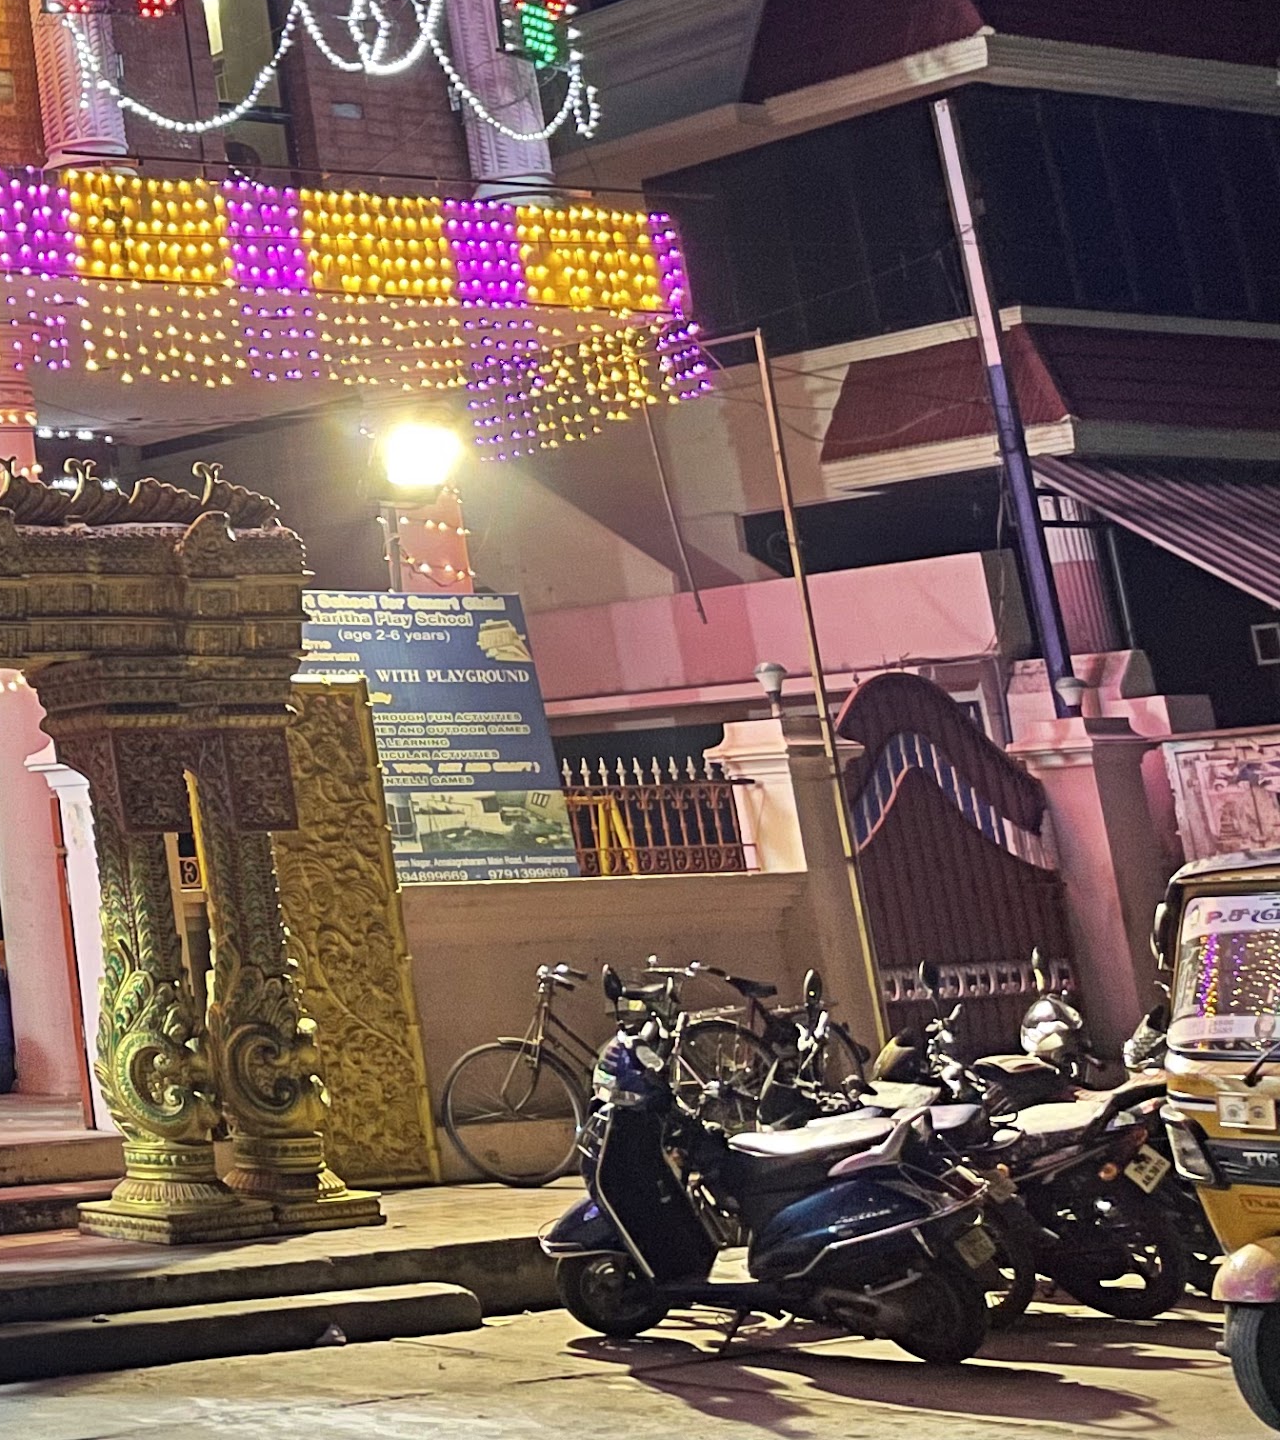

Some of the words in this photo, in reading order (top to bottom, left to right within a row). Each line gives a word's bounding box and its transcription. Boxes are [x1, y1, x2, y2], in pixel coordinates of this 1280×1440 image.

[375, 612, 411, 628] Play
[415, 612, 472, 626] School
[338, 628, 372, 642] (age
[376, 629, 400, 641] 2-6
[405, 629, 451, 642] years)
[375, 669, 420, 683] WITH
[426, 669, 530, 683] PLAYGROUND
[373, 713, 426, 722] HROUGH
[427, 713, 453, 722] FUN
[455, 712, 521, 722] ACTIVITIES
[398, 725, 425, 735] AND
[426, 725, 486, 735] OUTDOOR
[488, 724, 530, 734] GAMES
[385, 737, 450, 748] LEARNING
[432, 750, 500, 759] ACTIVITIES
[383, 776, 429, 786] NTELLI
[431, 775, 475, 785] GAMES
[1242, 1151, 1278, 1167] TVS
